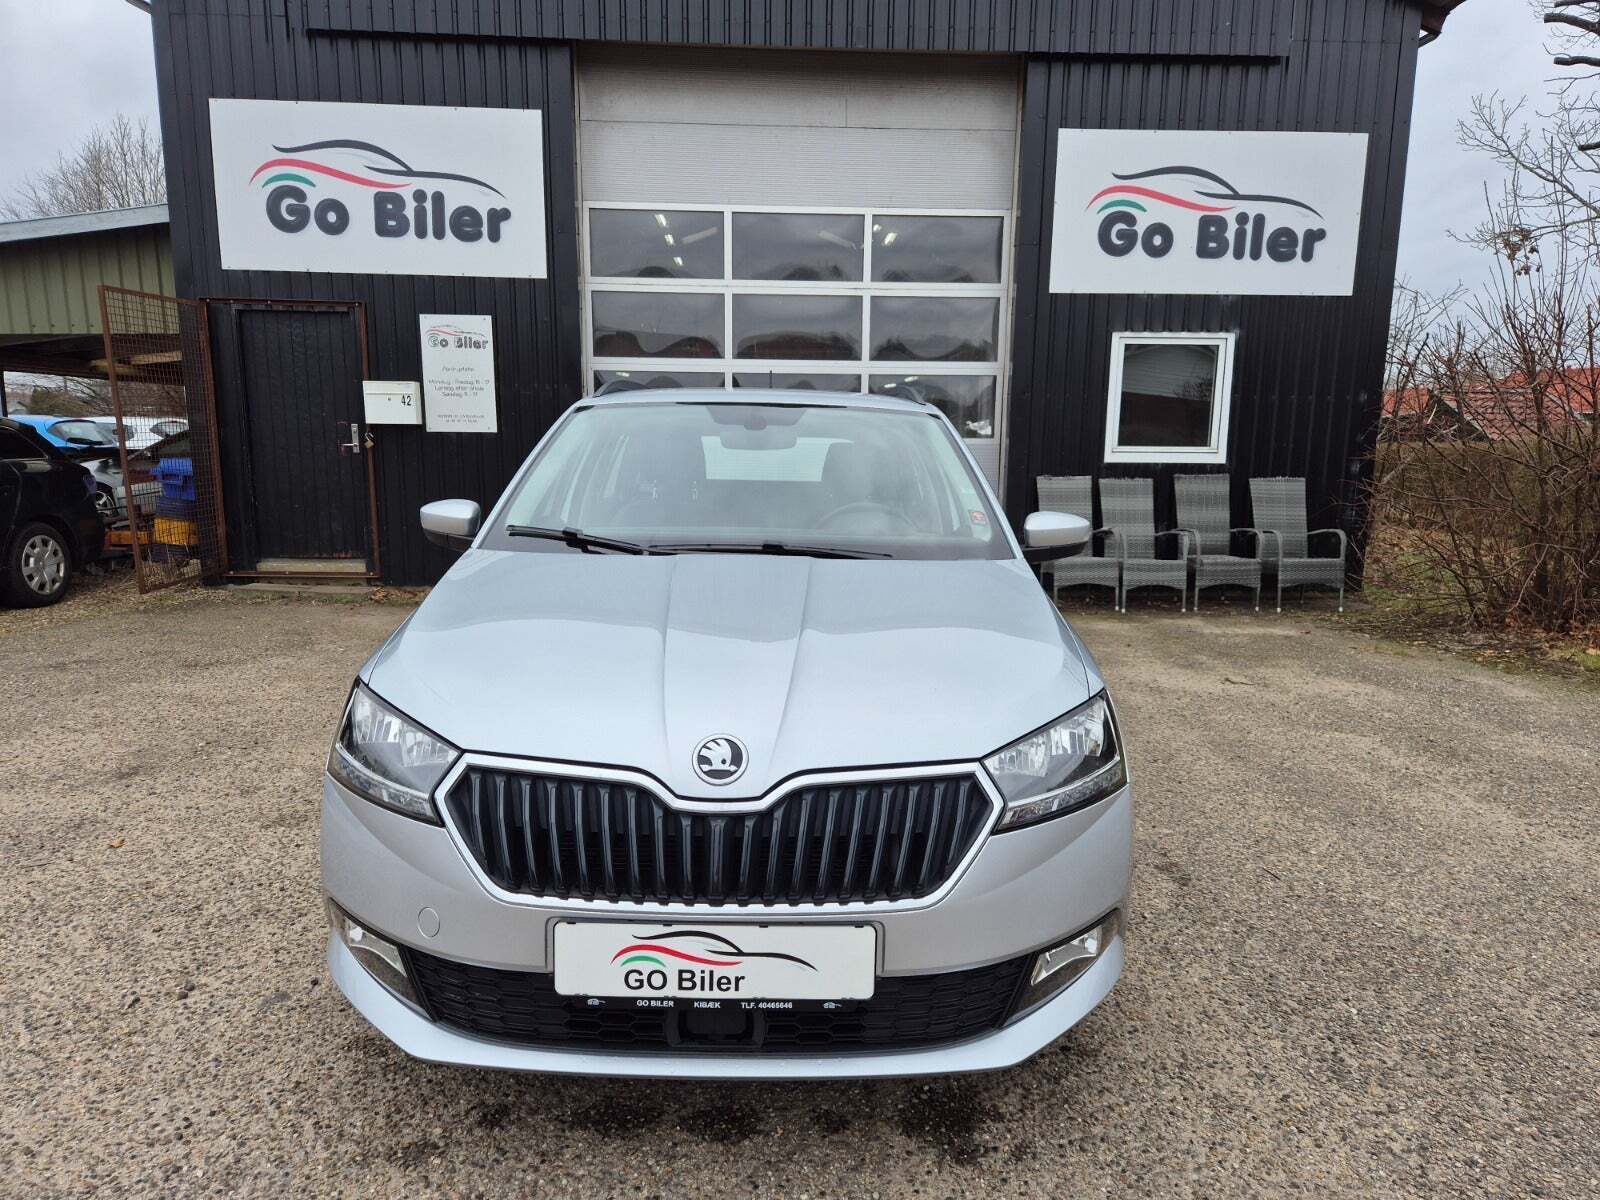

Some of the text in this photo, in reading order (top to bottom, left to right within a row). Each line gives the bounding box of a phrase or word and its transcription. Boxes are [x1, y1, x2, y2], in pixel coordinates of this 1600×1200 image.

[266, 187, 511, 243] Go Biler
[1097, 210, 1326, 263] Go Biler
[428, 335, 488, 349] Go Biler
[401, 395, 412, 406] 42
[623, 968, 746, 993] GO Biler
[636, 999, 649, 1007] GO
[650, 1000, 674, 1008] BILER
[693, 1001, 721, 1009] KIBÆK
[740, 1001, 756, 1009] TLF.
